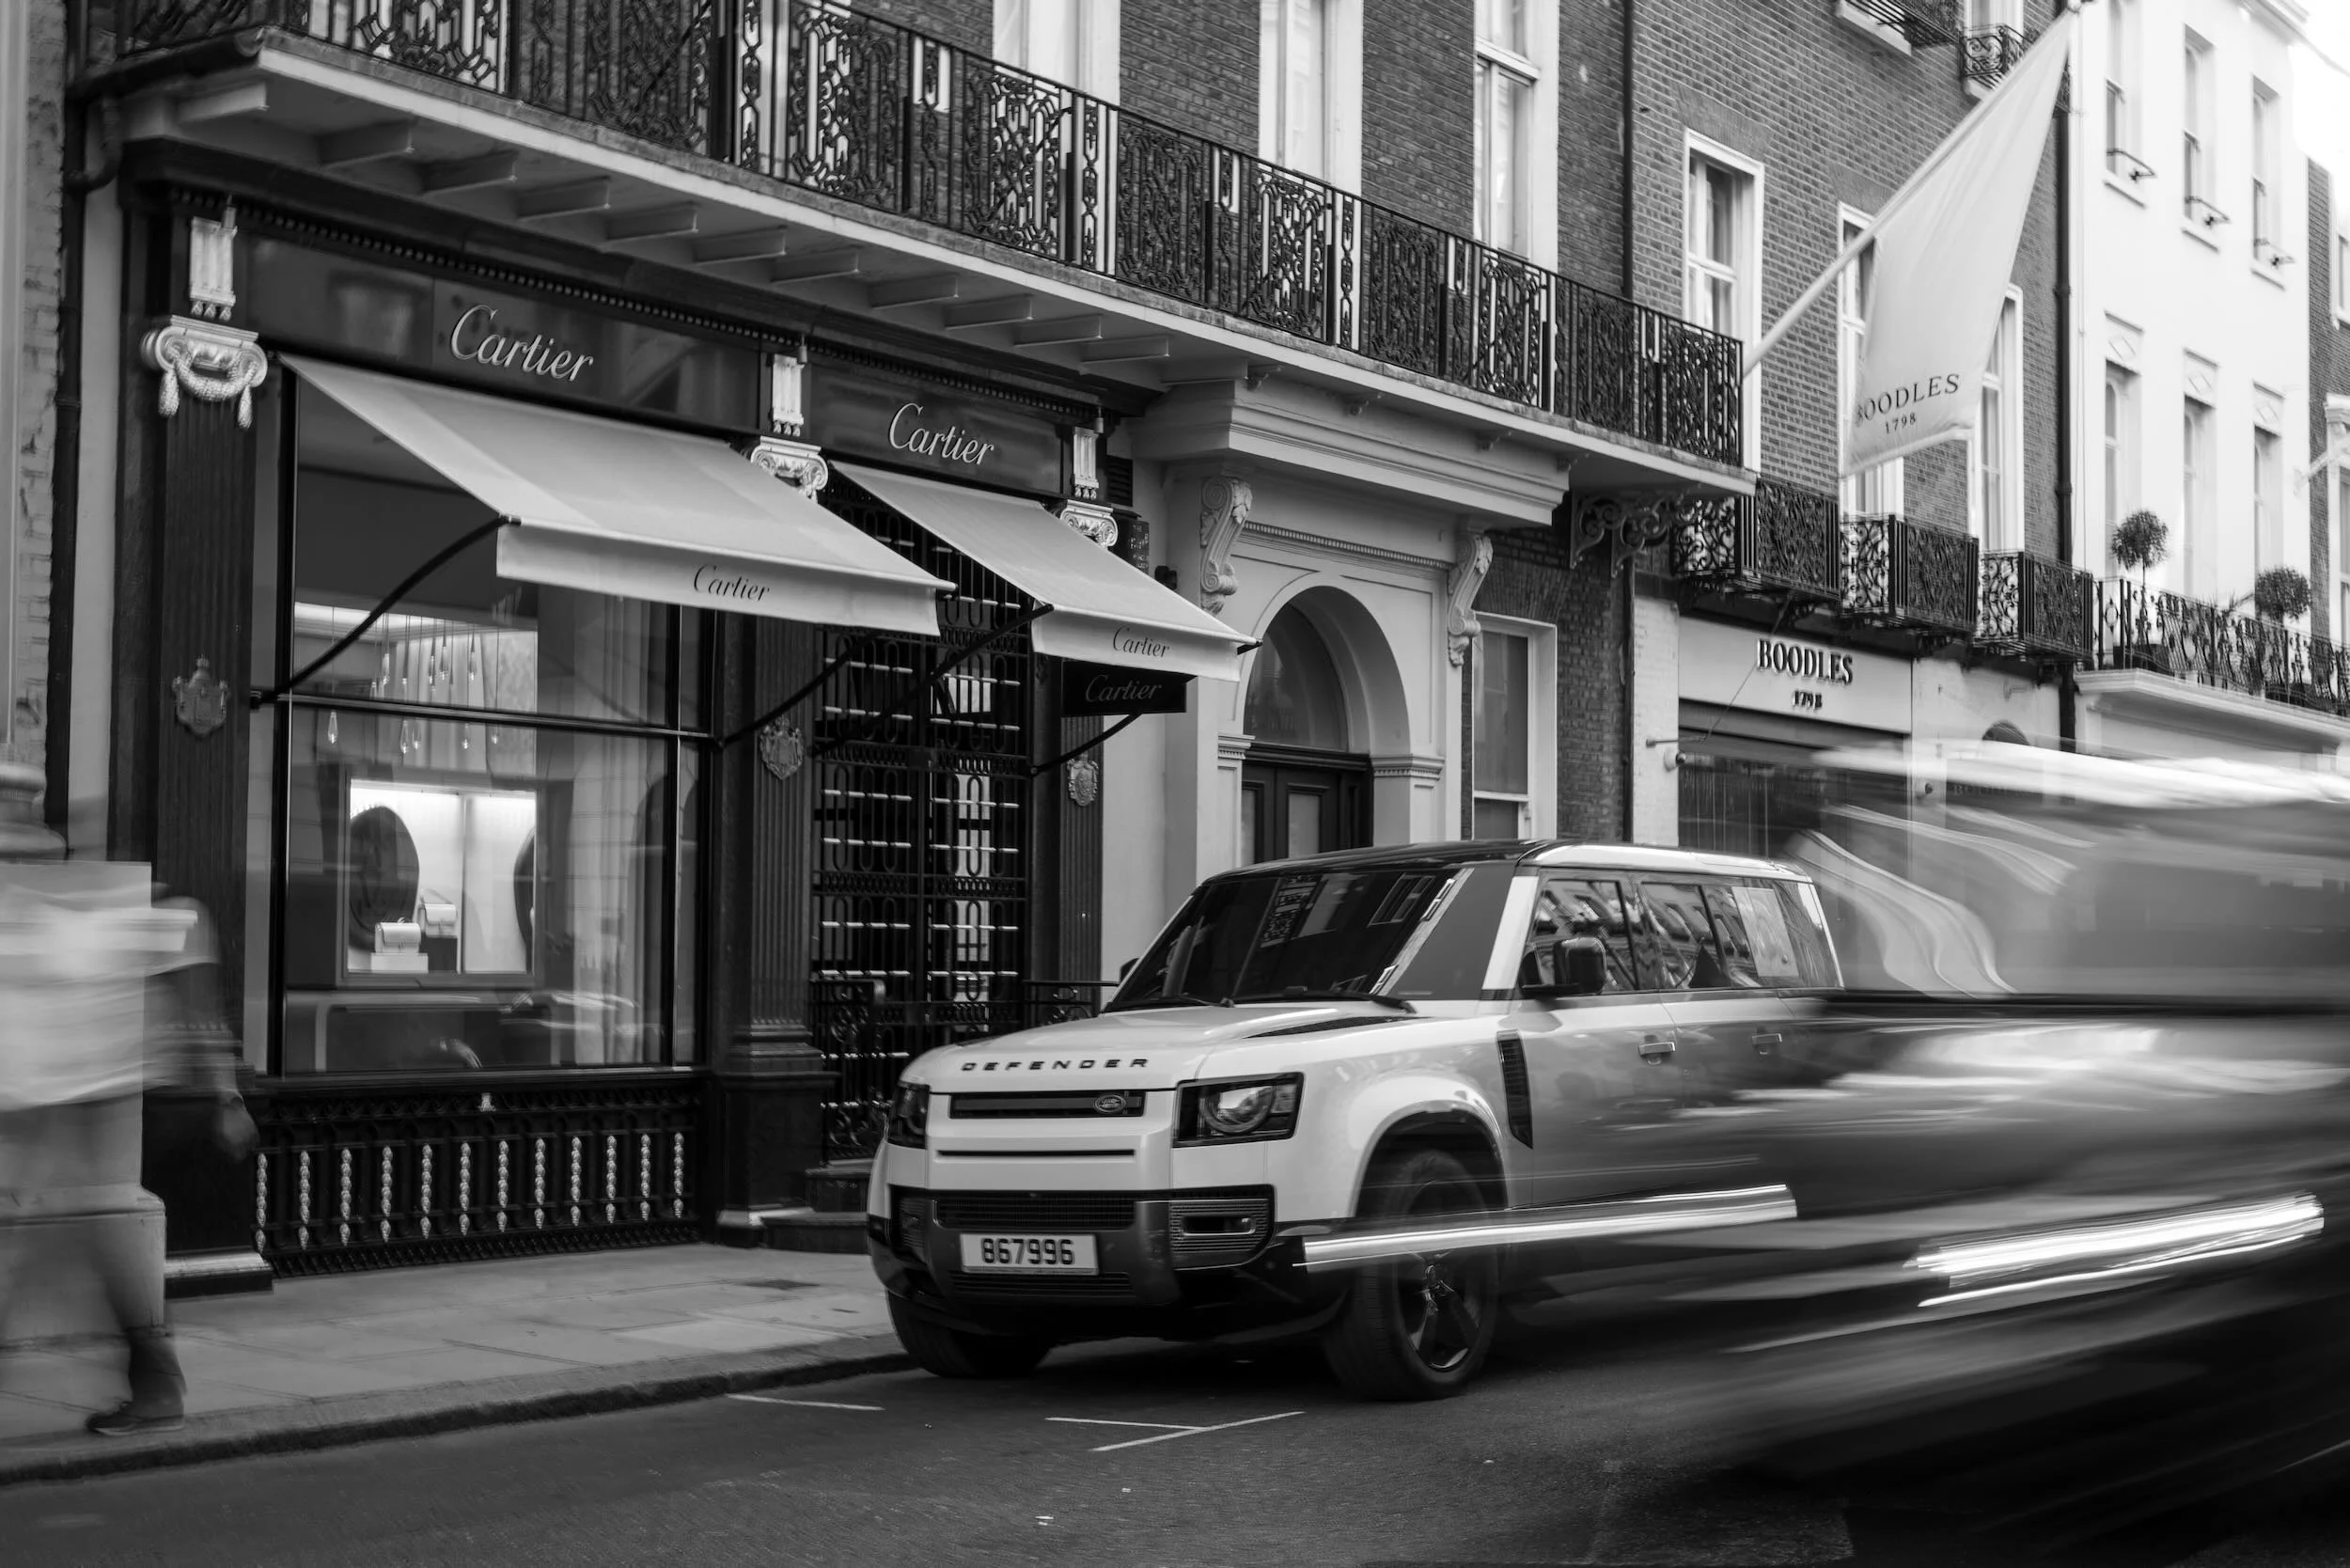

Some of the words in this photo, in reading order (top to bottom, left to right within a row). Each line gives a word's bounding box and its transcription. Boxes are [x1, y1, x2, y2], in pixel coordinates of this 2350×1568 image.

[450, 305, 594, 382] Cartier
[889, 402, 995, 464] Cartier
[1885, 412, 1916, 434] 1798
[694, 563, 770, 602] Cartier
[1113, 624, 1169, 657] Cartier
[1757, 638, 1853, 685] BOODLES
[1086, 675, 1163, 702] Cartier
[961, 1058, 1148, 1071] DEFENDER
[980, 1237, 1075, 1265] 867996
